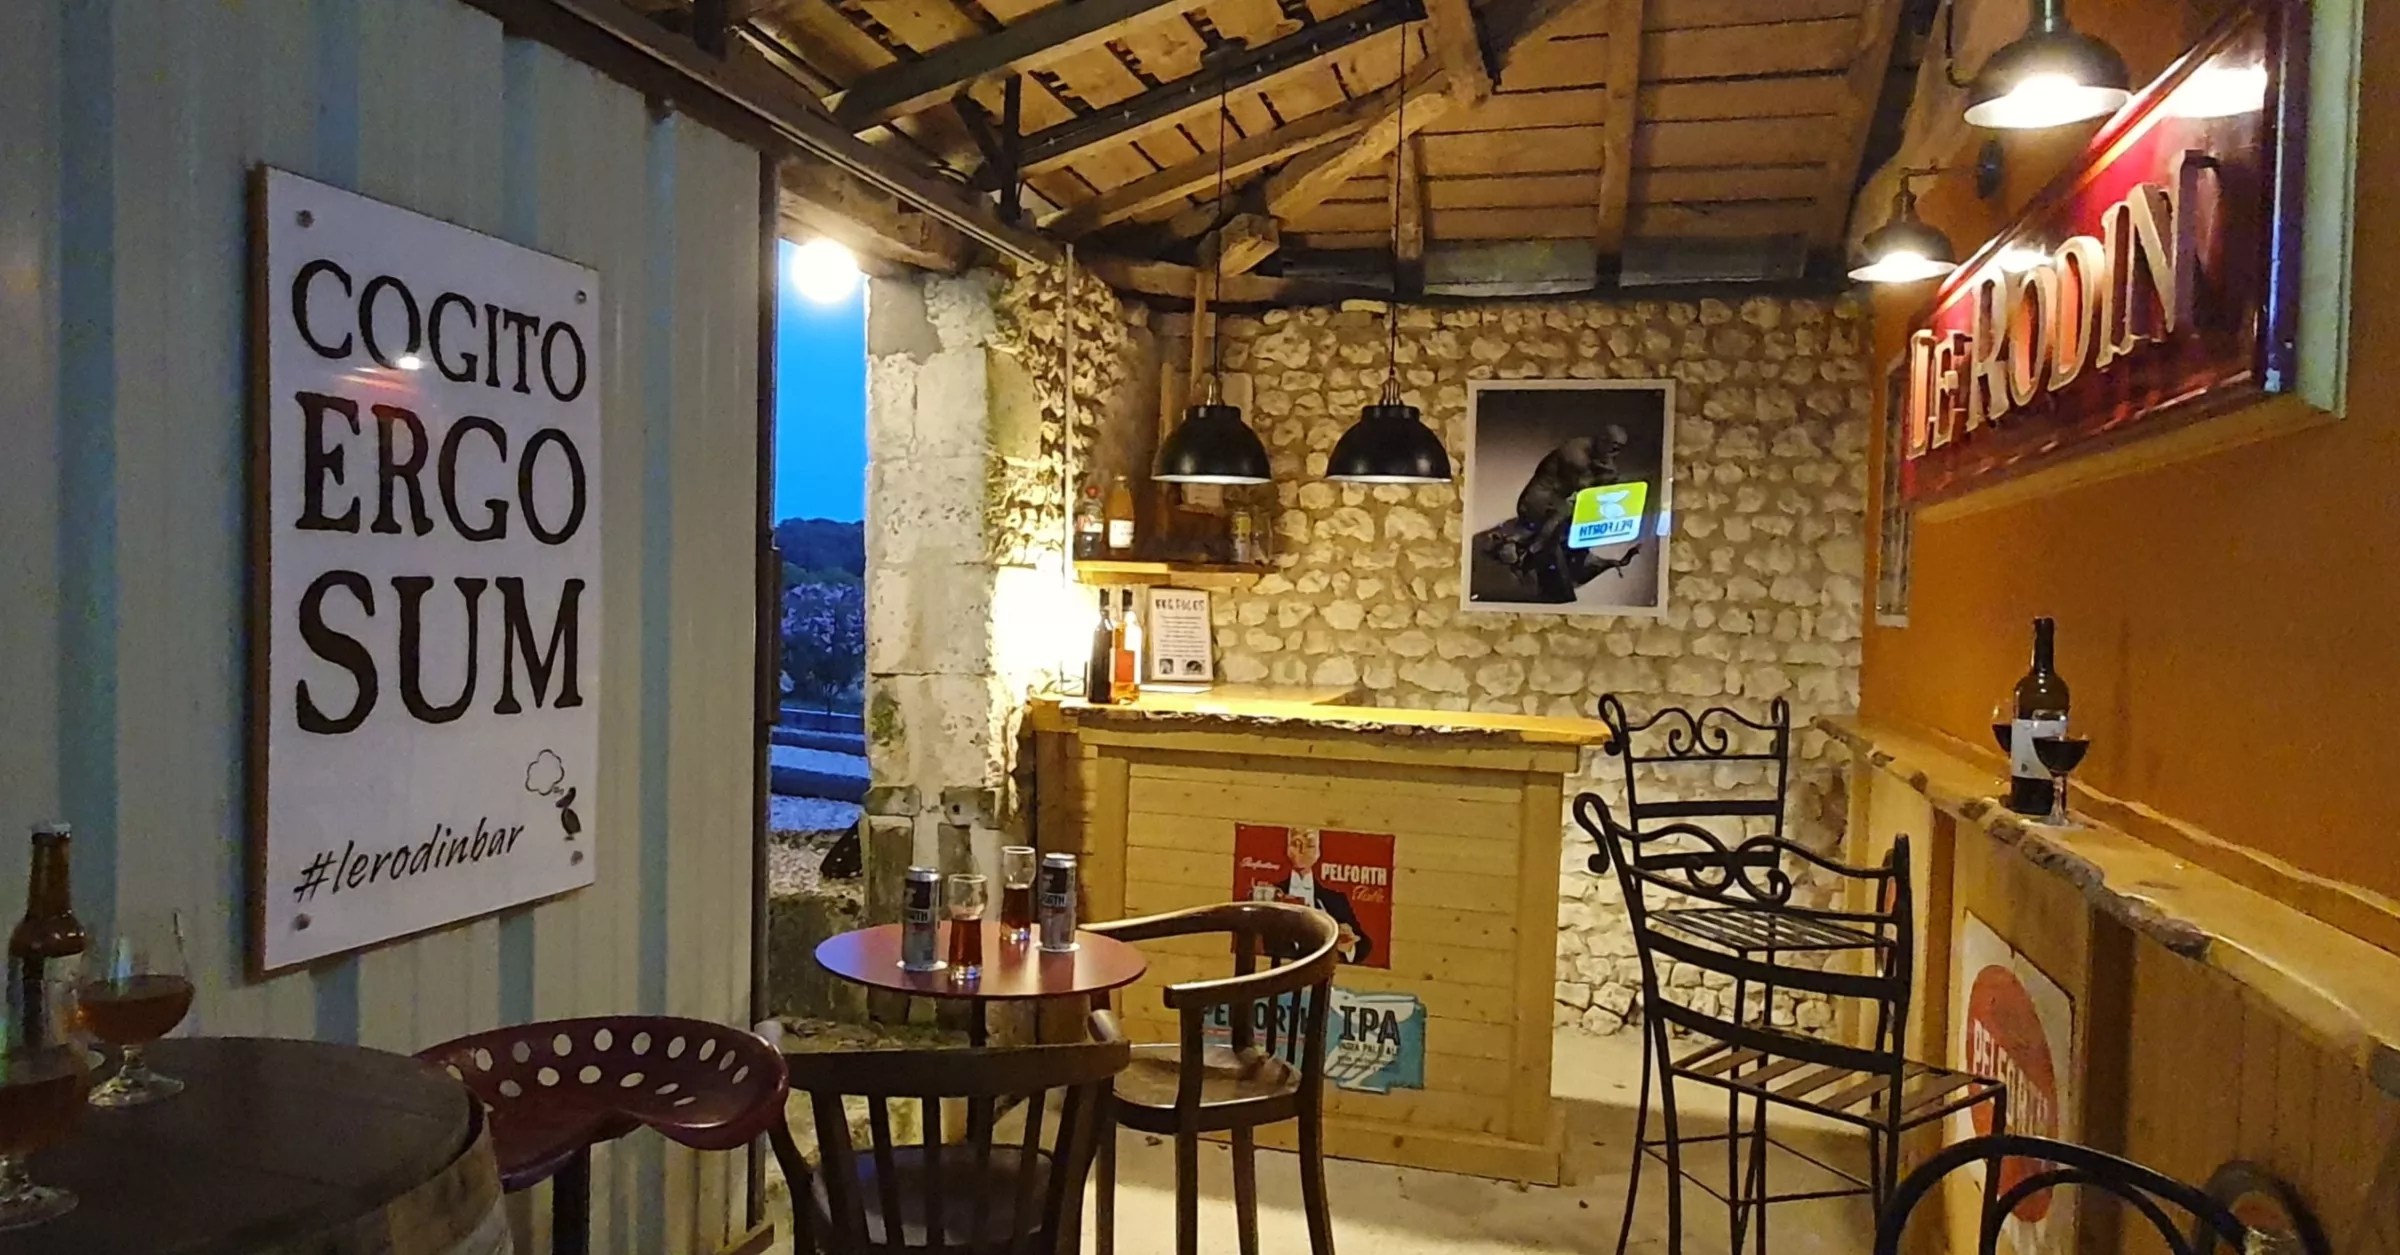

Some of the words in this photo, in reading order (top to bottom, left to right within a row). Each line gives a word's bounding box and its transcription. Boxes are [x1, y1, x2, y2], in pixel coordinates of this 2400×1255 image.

[292, 259, 587, 403] COGITO
[1966, 148, 2223, 434] RODIN
[294, 390, 587, 546] ERGO
[296, 569, 586, 736] SUM
[294, 819, 526, 903] #lerodinbar
[1321, 862, 1387, 887] PELFORTH
[1340, 1004, 1401, 1046] IPA
